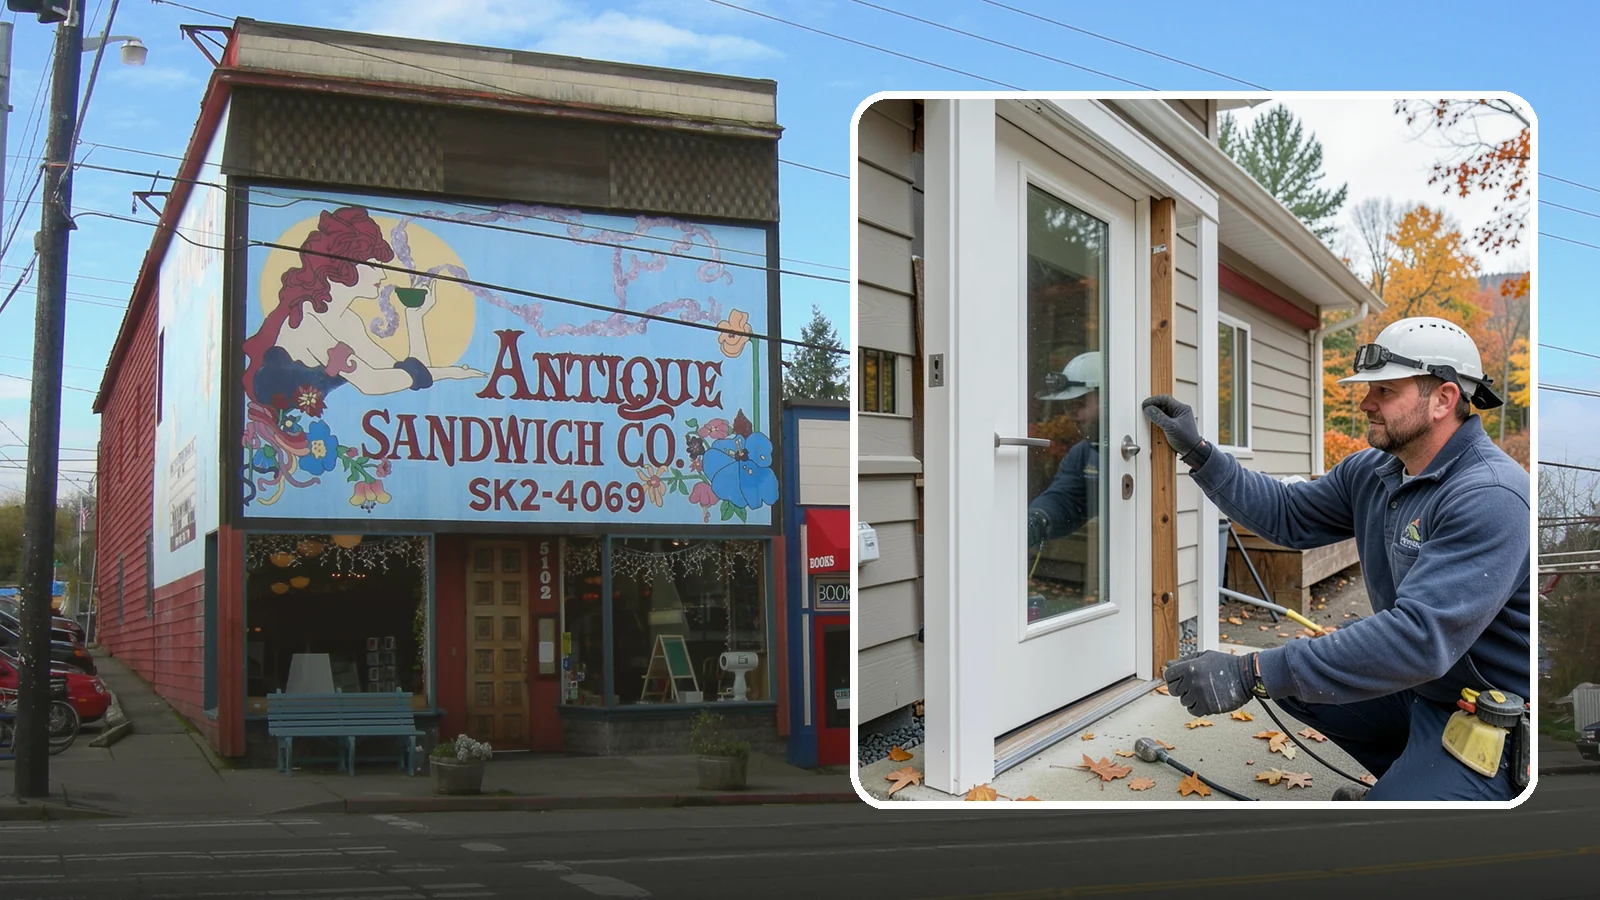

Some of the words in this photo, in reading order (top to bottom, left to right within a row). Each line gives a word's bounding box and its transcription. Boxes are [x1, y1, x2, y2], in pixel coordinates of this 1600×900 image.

[476, 329, 723, 421] ANTIQUE
[362, 409, 604, 467] SANDWICH
[617, 422, 685, 468] CO.
[468, 477, 646, 513] SK2-4069
[540, 541, 552, 599] 5102
[809, 555, 835, 568] BOOKS
